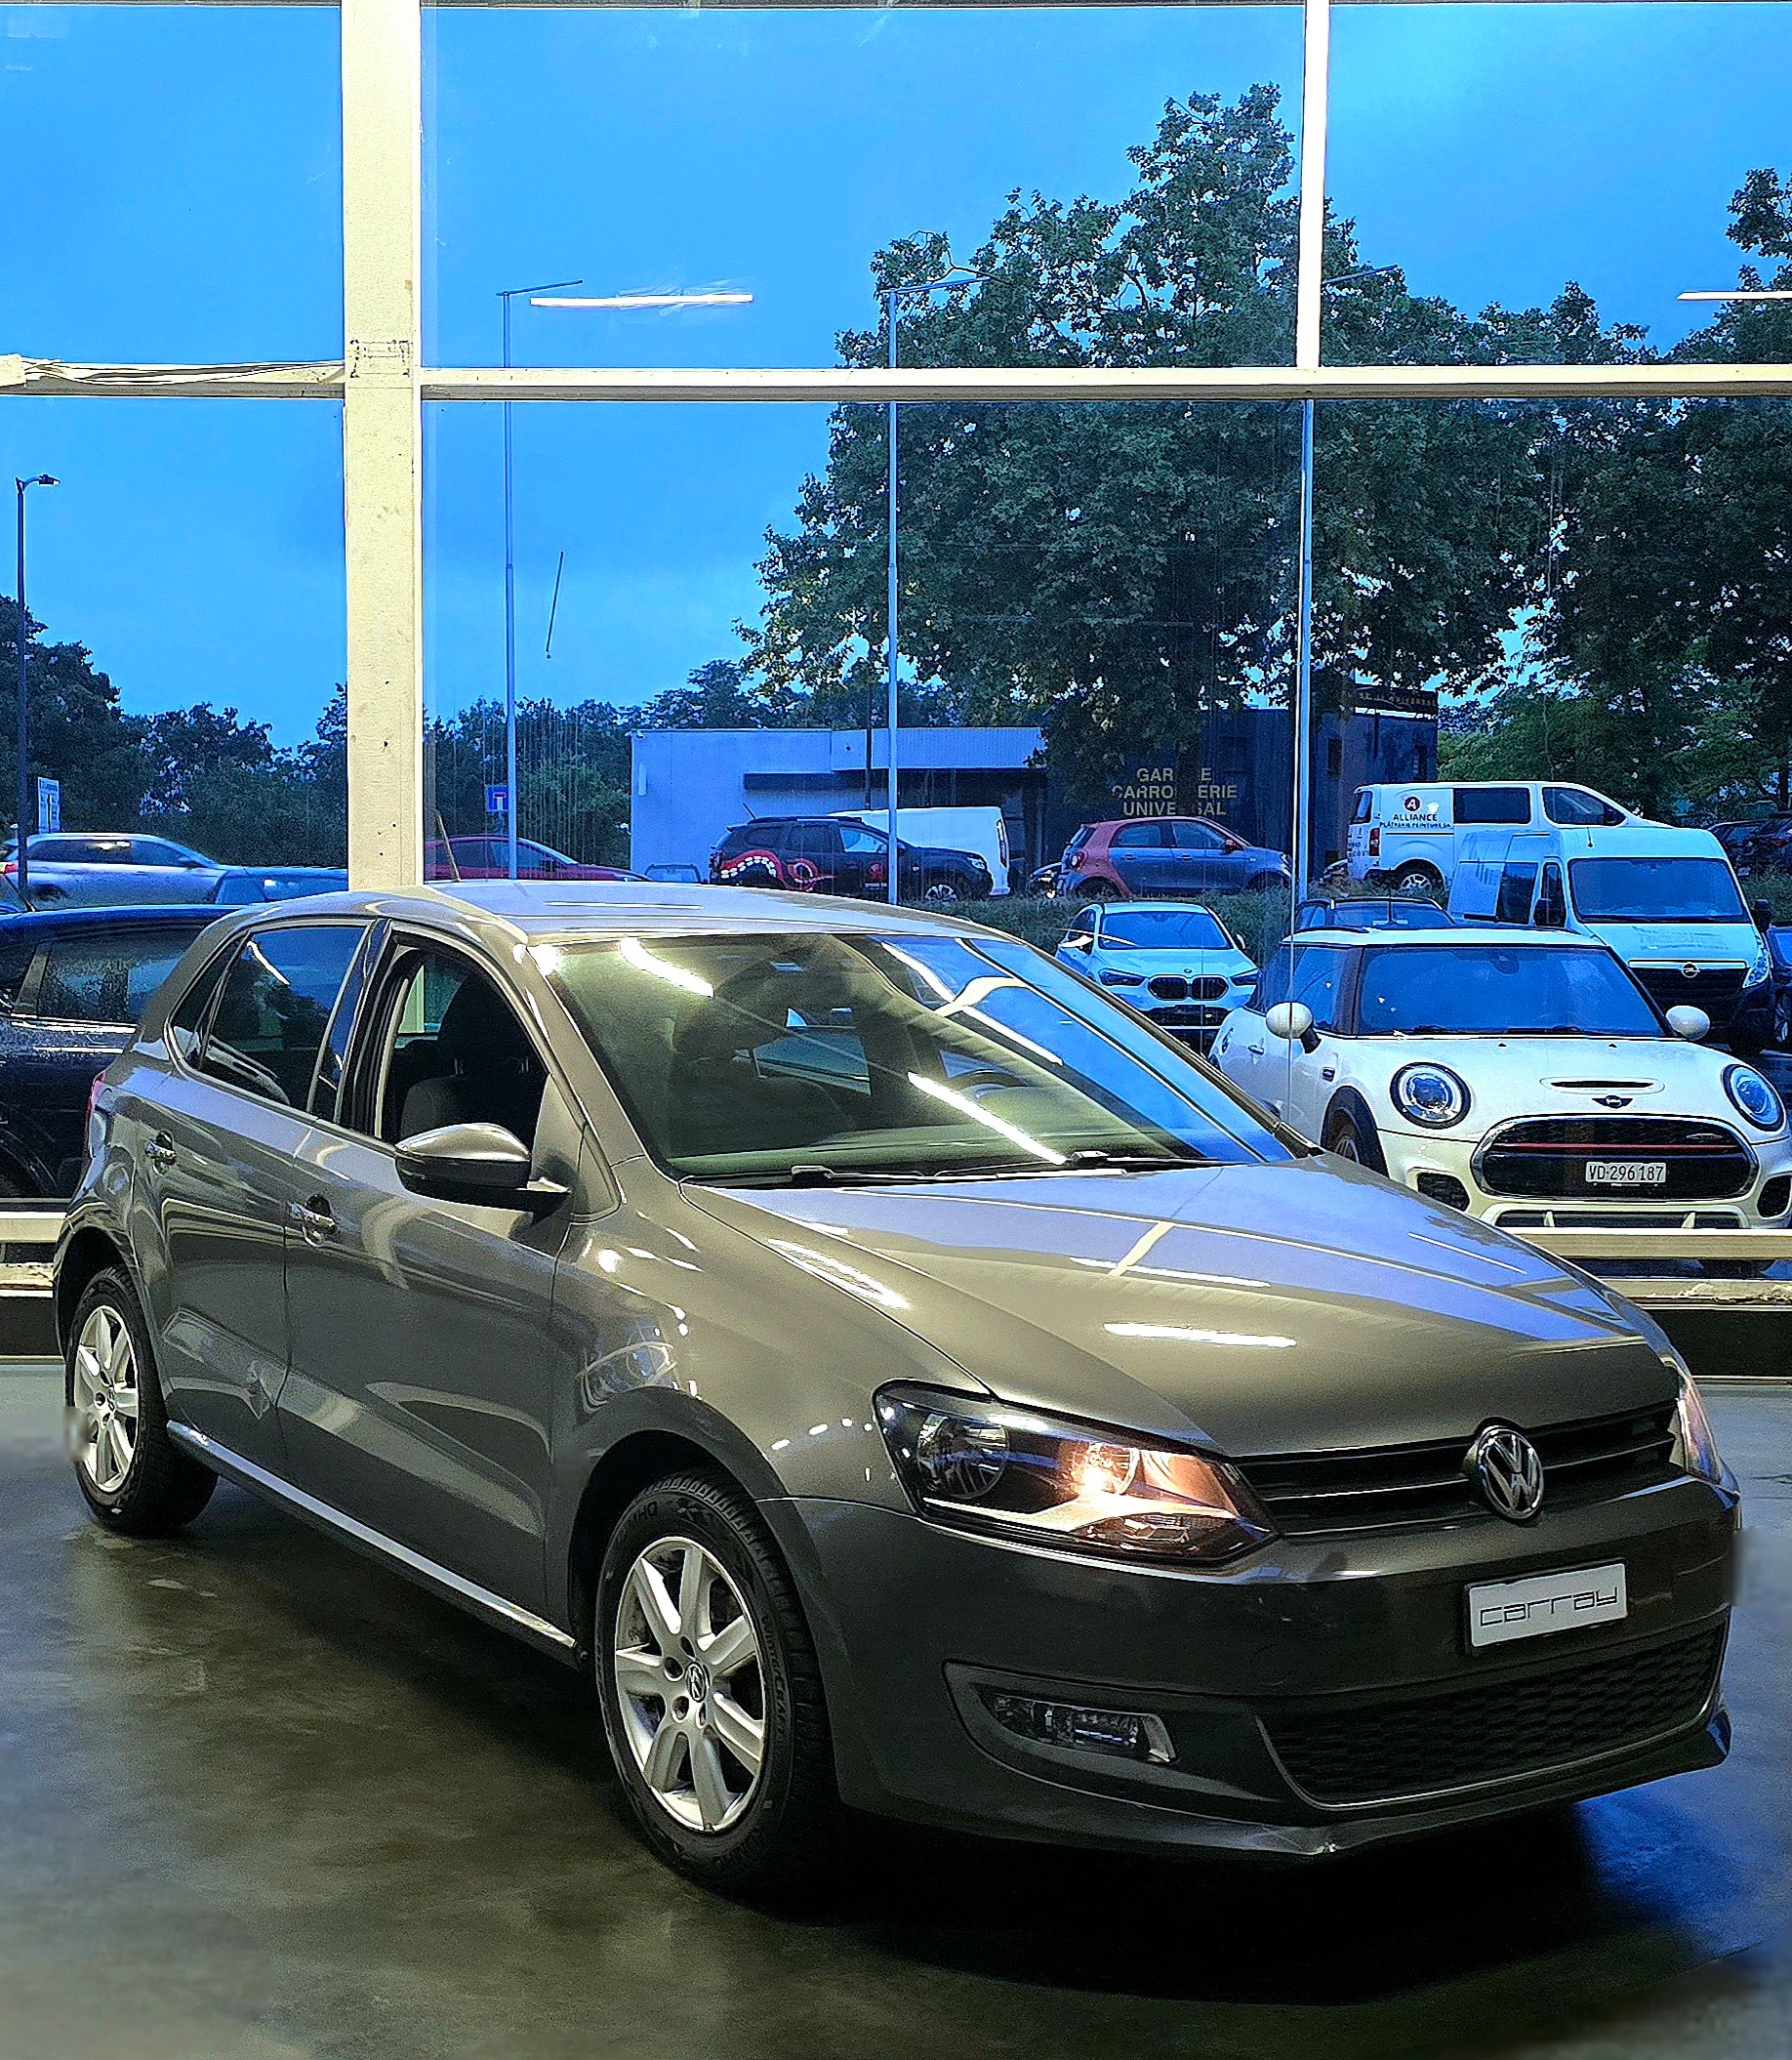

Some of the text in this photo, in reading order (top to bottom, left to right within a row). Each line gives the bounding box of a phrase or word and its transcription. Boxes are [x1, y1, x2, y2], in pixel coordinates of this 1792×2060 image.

[1136, 767, 1212, 782] GARE
[1111, 784, 1238, 799] CARROERIE
[1393, 813, 1438, 822] ALLIANCE
[1480, 1586, 1618, 1627] carray
